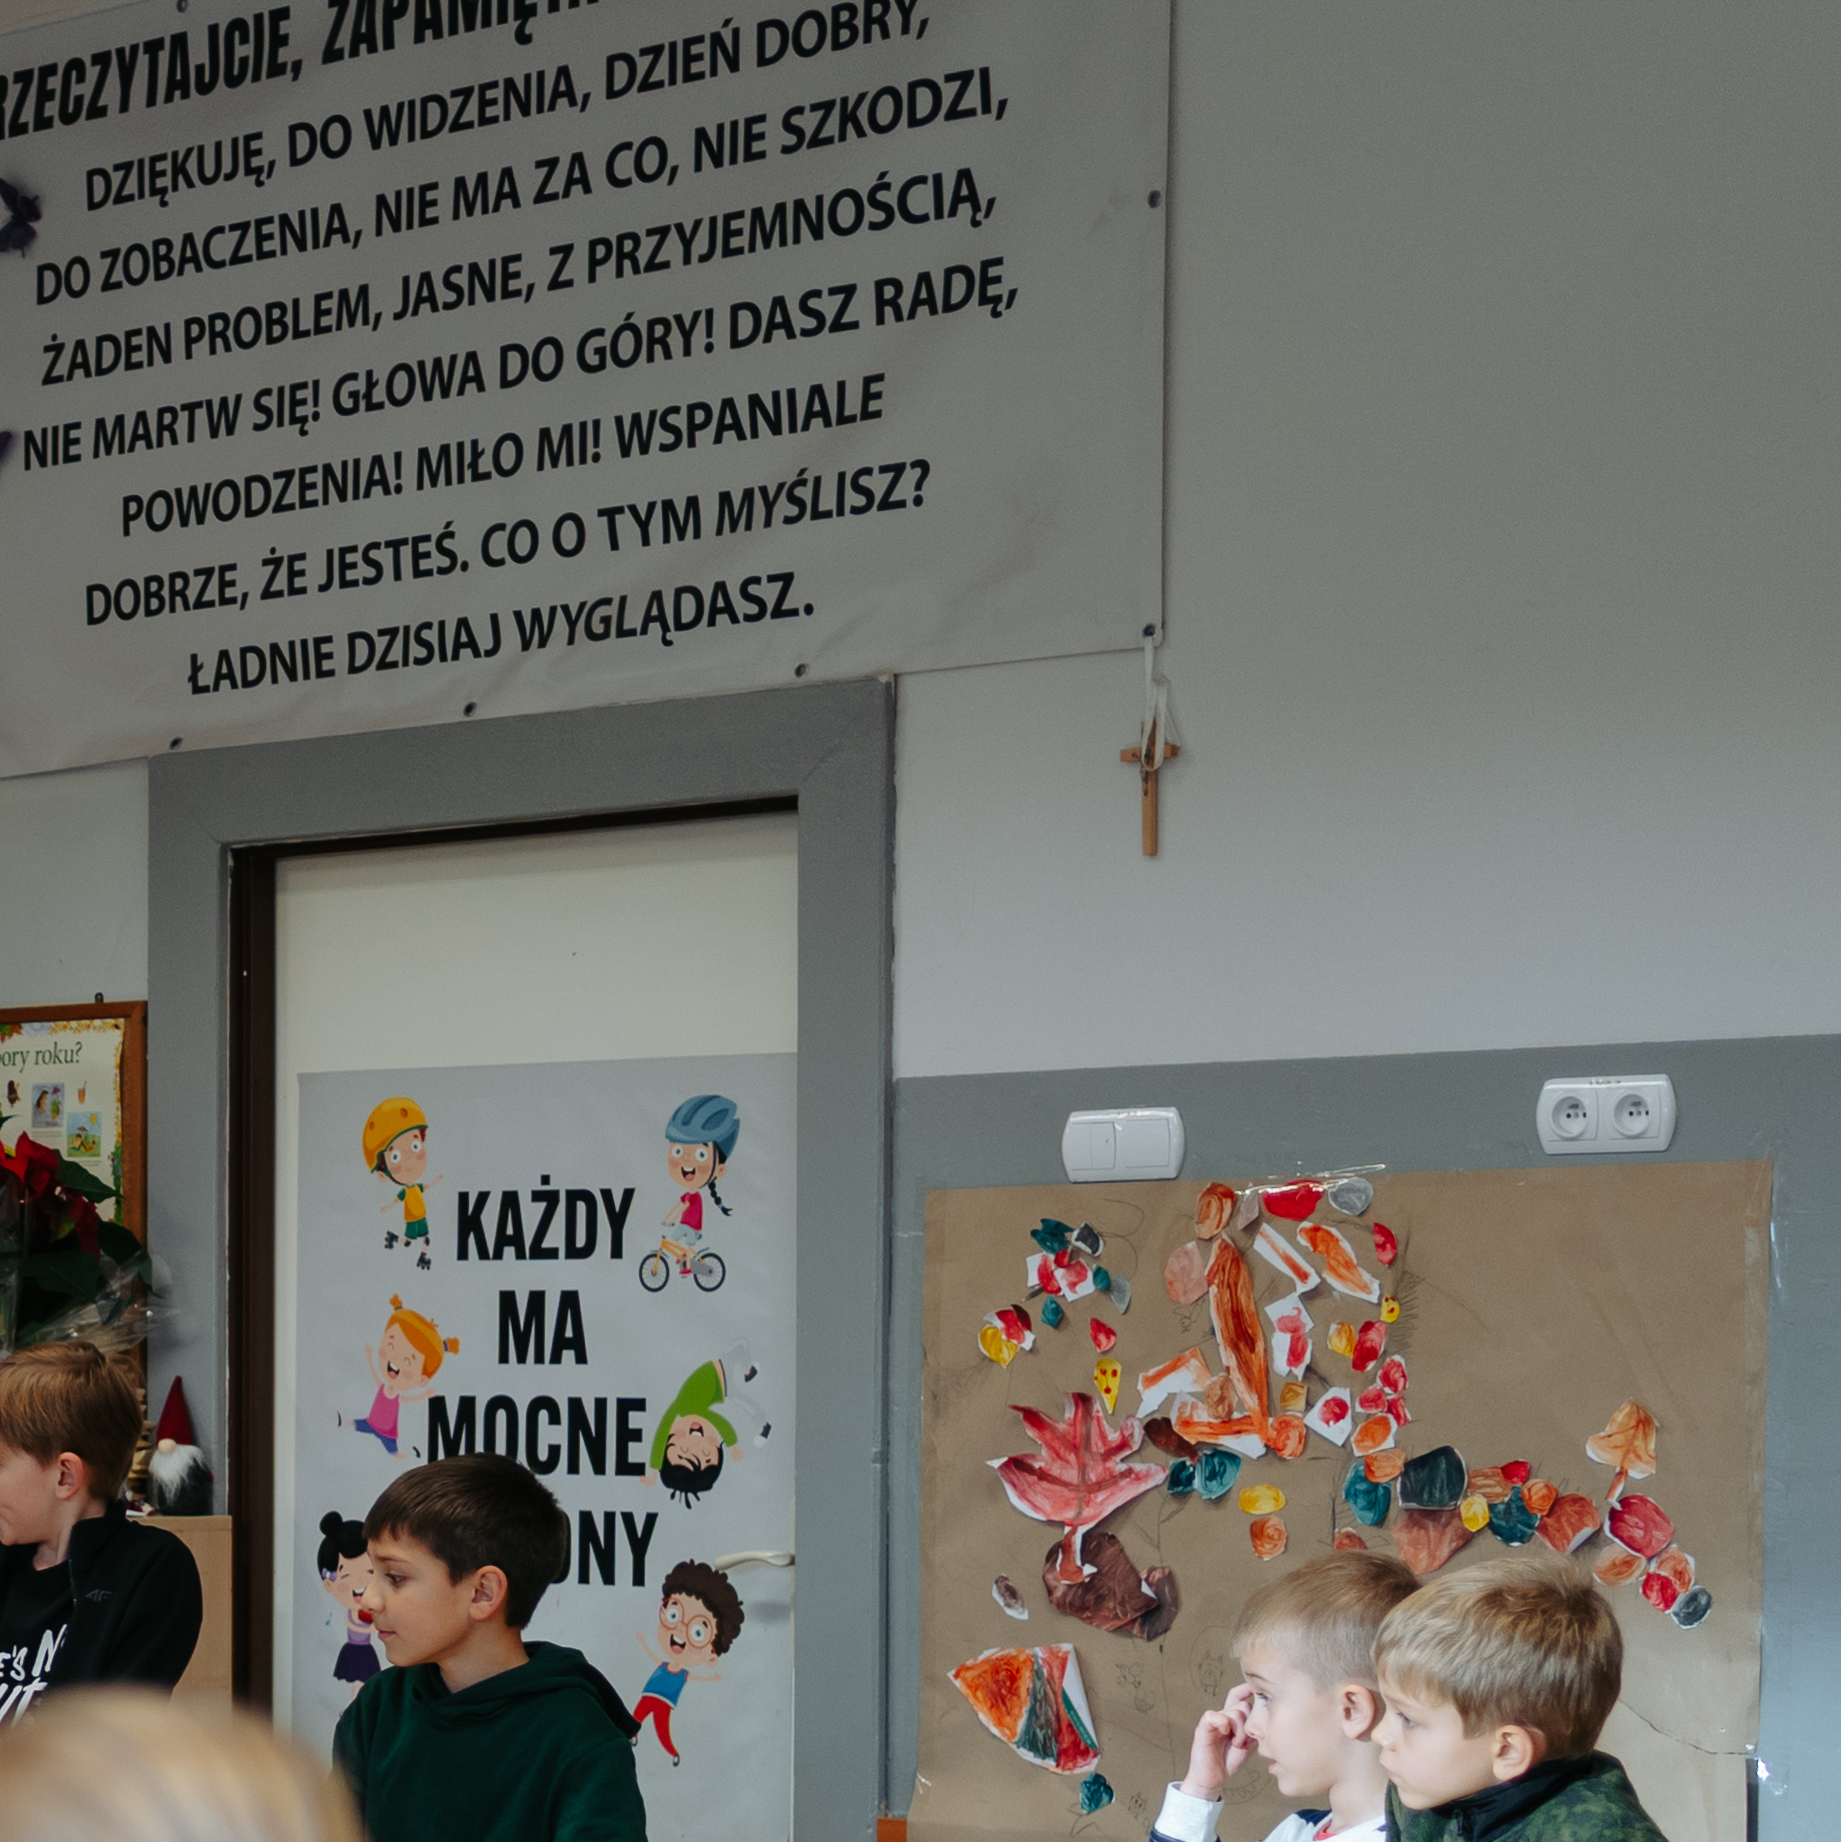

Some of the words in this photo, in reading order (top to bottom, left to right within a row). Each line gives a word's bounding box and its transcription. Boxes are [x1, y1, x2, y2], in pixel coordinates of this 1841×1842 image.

[321, 0, 600, 66] ZAPAMĘ
[85, 130, 277, 212] DZIĘKUJĘ,
[287, 114, 353, 168] DO
[362, 64, 592, 151] WIDZENIA,
[605, 17, 741, 101] DZIEŃ
[756, 0, 930, 68] DOBRY,
[36, 255, 91, 306] DO
[99, 202, 363, 293] ZOBACZENIA,
[375, 181, 440, 238] NIE
[452, 165, 522, 221] MA
[532, 151, 593, 205] ZA
[605, 135, 680, 189] CO,
[693, 113, 767, 174] NIE
[780, 66, 1009, 155] SZKODZI,
[41, 321, 173, 387] ŻADEN
[183, 283, 383, 361] PROBLEM,
[392, 252, 536, 321] JASNE,
[546, 242, 575, 292] Z
[587, 167, 997, 284] PRZYJEMNOŚCIĄ,
[23, 421, 82, 471] NIE
[92, 393, 243, 460] MARTW
[252, 378, 321, 437] SIĘ!
[332, 350, 486, 417] GŁOWA
[499, 336, 564, 390] DO
[576, 307, 715, 374] GÓRY!
[729, 283, 860, 350] DASZ
[874, 256, 1018, 327] RADĘ,
[122, 450, 403, 537] POWODZENIA!
[416, 432, 524, 491] MIŁO
[536, 418, 601, 472] MI!
[613, 372, 885, 459] WSPANIALE
[85, 562, 249, 626] DOBRZE,
[259, 546, 308, 601] ŻE
[317, 520, 469, 593] JESTEŚ.
[480, 518, 540, 568] CO
[552, 512, 586, 558] O
[597, 495, 702, 552] TYM
[715, 458, 931, 537] MYŚLISZ?
[187, 635, 336, 695] ŁADNIE
[347, 612, 502, 675] DZISIAJ
[512, 571, 815, 653] WYGLĄDASZ.
[34, 1041, 83, 1065] roku?
[456, 1174, 636, 1262] KAŻDY
[497, 1289, 590, 1366] MA
[427, 1394, 648, 1477] MOCNE
